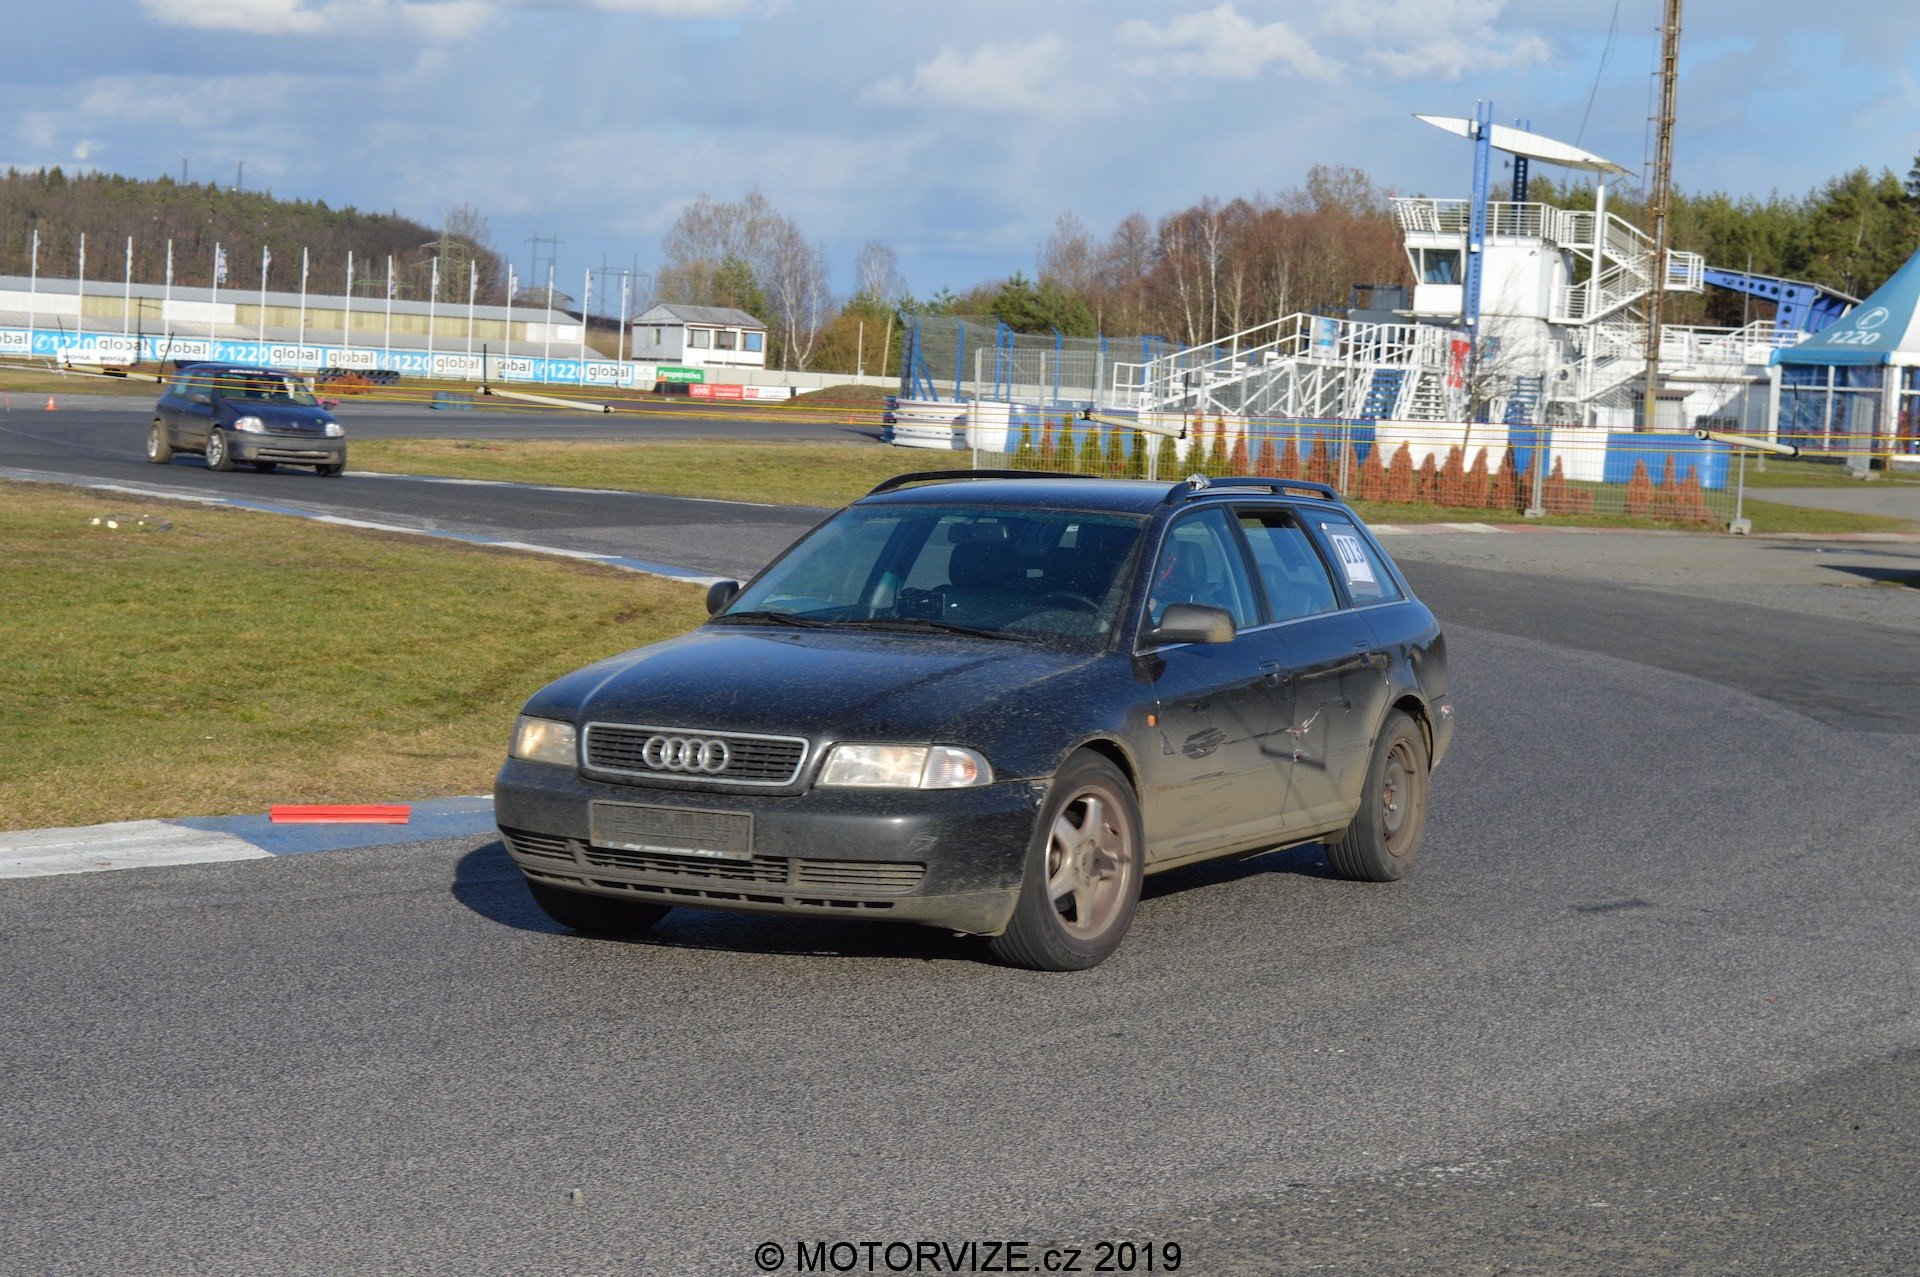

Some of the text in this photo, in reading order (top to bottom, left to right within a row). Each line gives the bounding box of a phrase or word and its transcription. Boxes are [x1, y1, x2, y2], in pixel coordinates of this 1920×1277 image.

[1827, 331, 1881, 345] 1220
[159, 342, 206, 358] gobal
[227, 346, 269, 362] 1220
[273, 347, 319, 363] global
[329, 351, 374, 368] global
[392, 354, 433, 371] 1220
[436, 356, 480, 372] global
[549, 363, 586, 379] 1220
[589, 365, 629, 380] global
